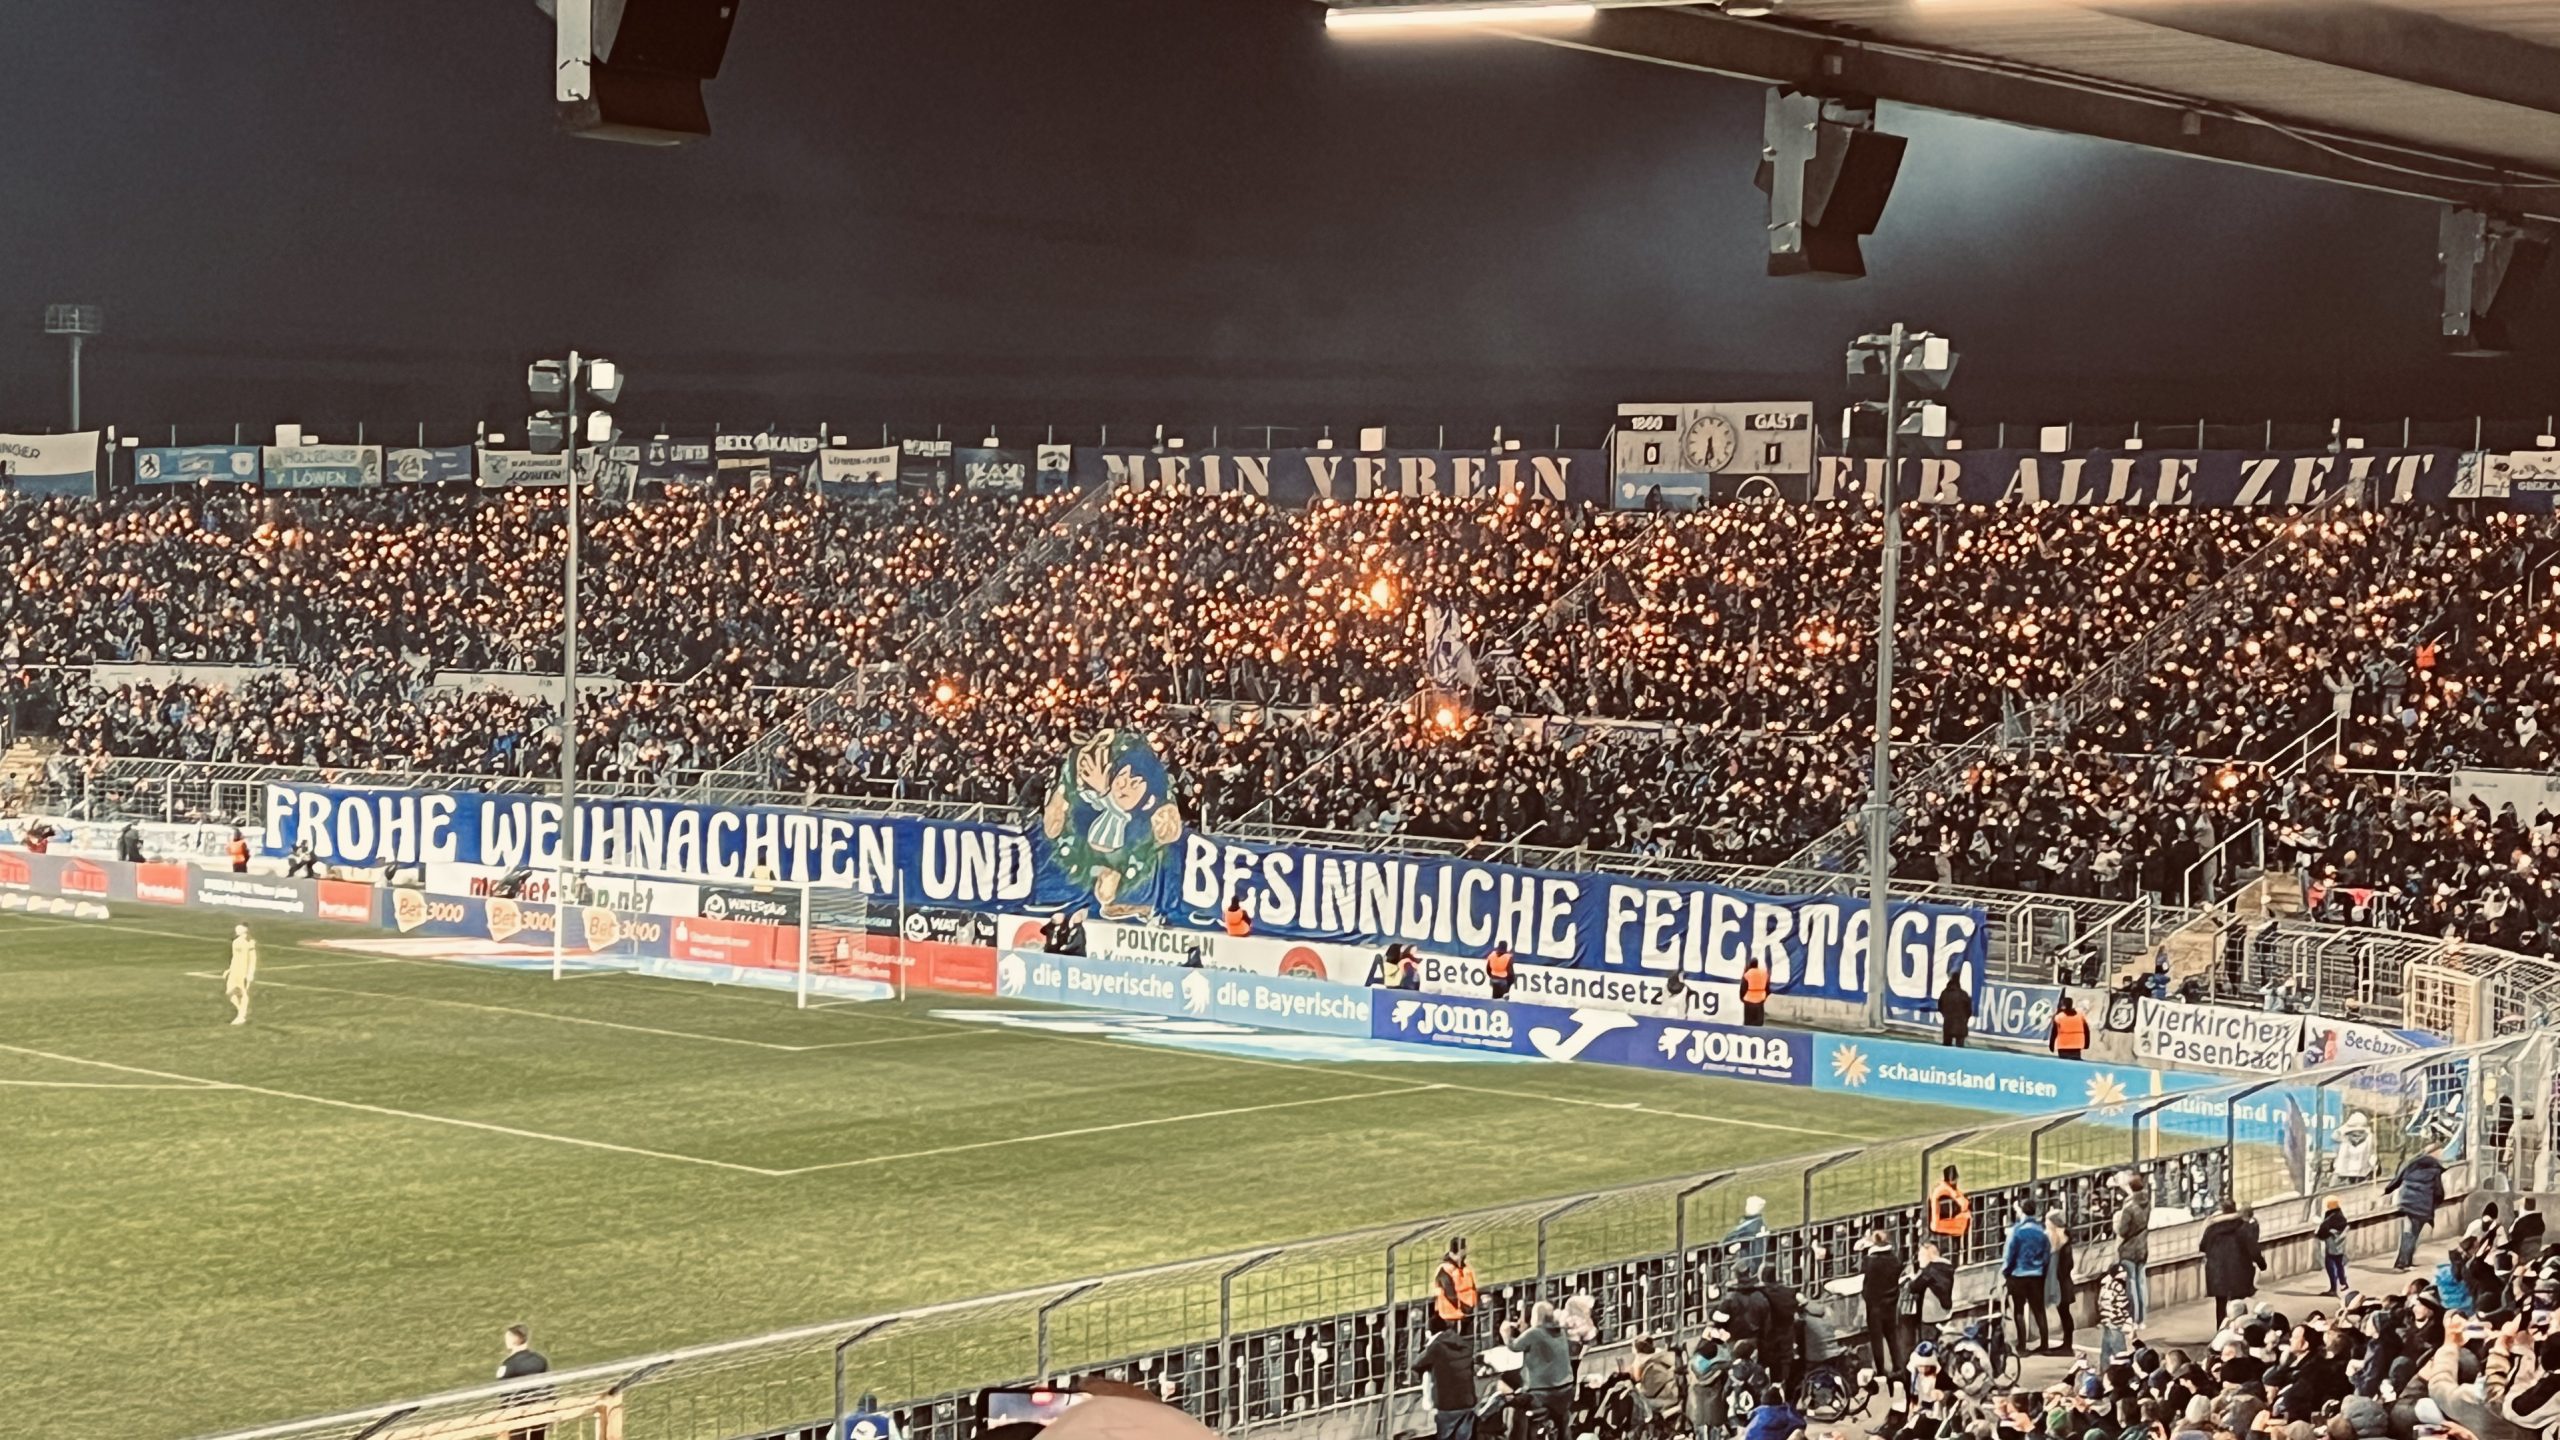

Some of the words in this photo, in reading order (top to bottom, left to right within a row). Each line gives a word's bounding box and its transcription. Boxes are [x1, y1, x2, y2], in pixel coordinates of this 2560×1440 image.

[1754, 412, 1798, 431] GAST
[1646, 445, 1657, 463] 0
[1769, 445, 1777, 463] 1
[1102, 454, 1272, 498] MEIN
[1304, 456, 1572, 501] VEREIN
[2003, 457, 2198, 506] ALLE
[2232, 453, 2435, 505] ZEIT
[266, 783, 457, 864] FROHE
[480, 800, 895, 895] WEIHNACHTEN
[921, 825, 1035, 902] UND
[1181, 832, 1581, 960] BESINNLICHE
[1605, 883, 1976, 999] FEIERTAGE
[1116, 927, 1214, 957] POLYCLEN
[1032, 963, 1062, 988] die
[1067, 967, 1174, 999] Bayerische
[1216, 981, 1250, 1008] die
[1255, 985, 1369, 1022] Bayerische
[2140, 1000, 2291, 1042] Vierkirchen
[2157, 1031, 2292, 1072] Pasenbach
[1878, 1062, 1996, 1091] schauinsland
[1999, 1075, 2058, 1098] reisen
